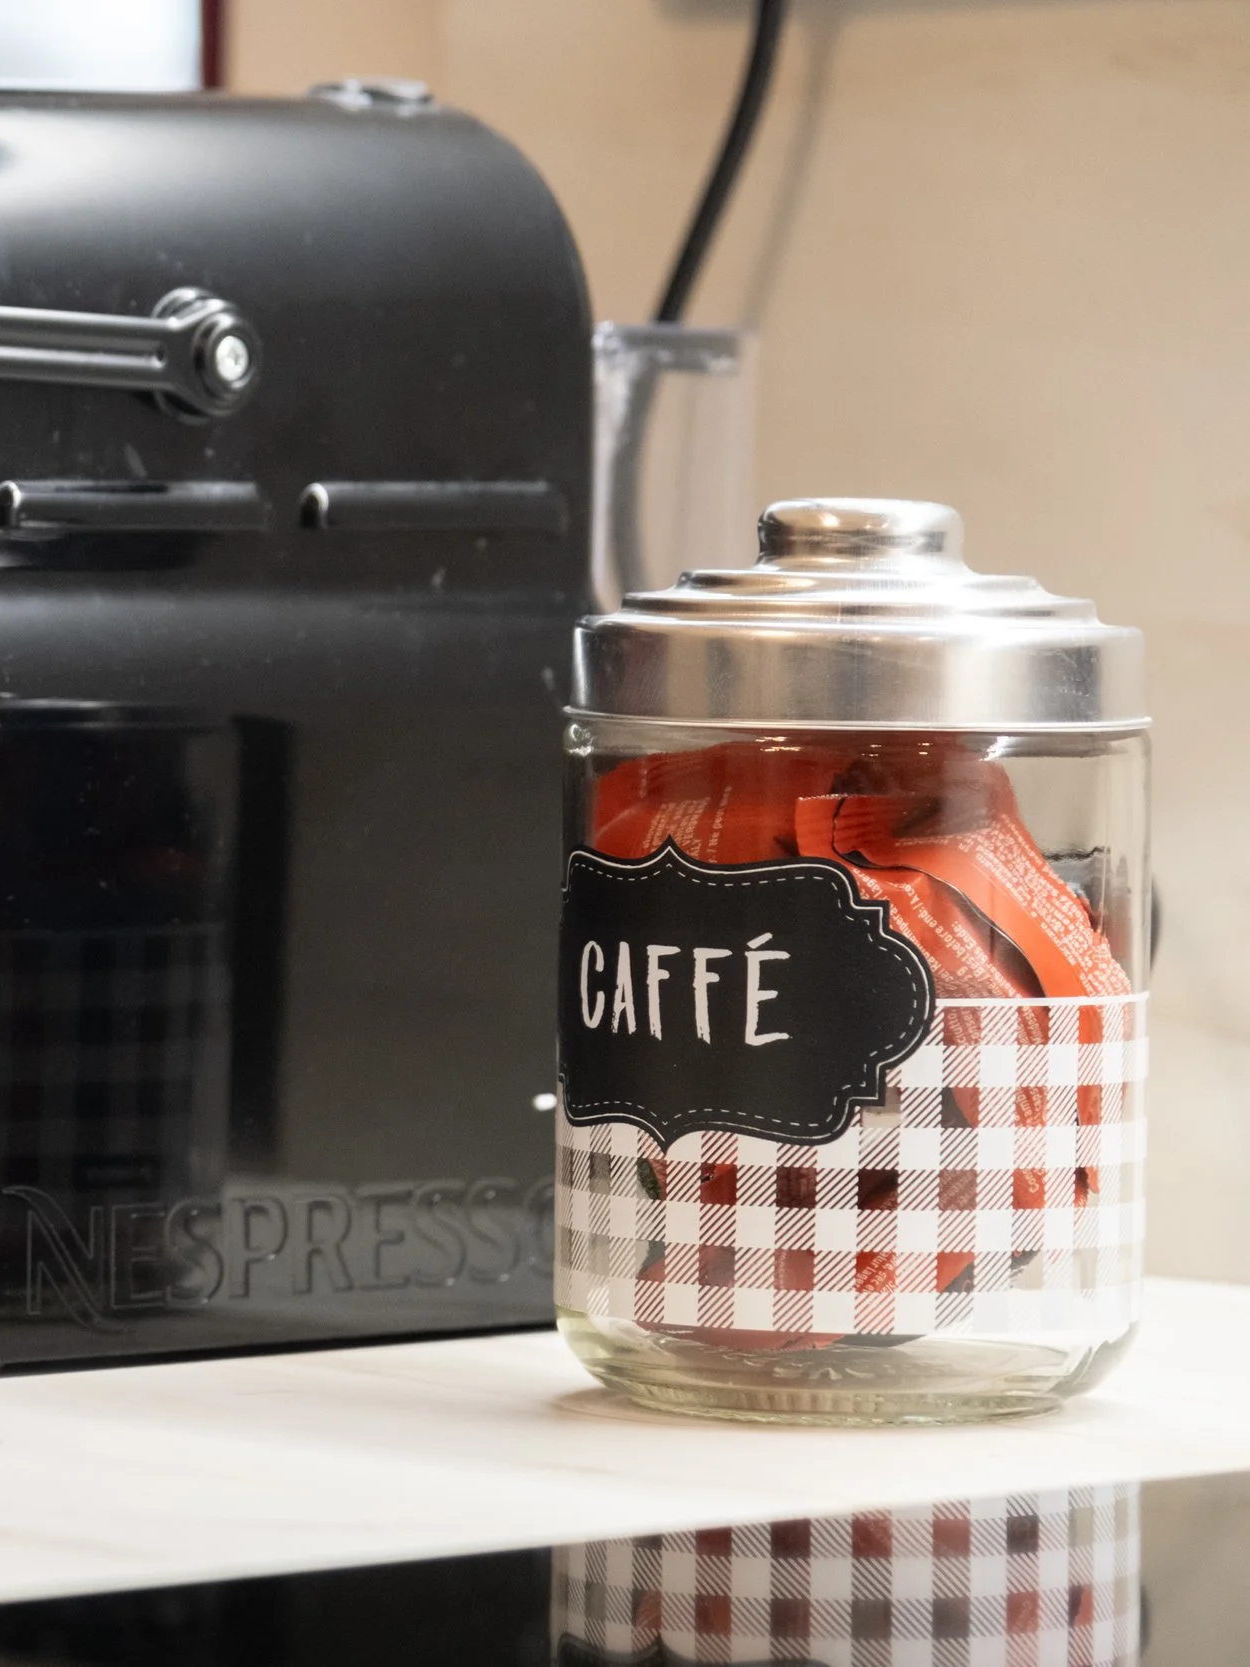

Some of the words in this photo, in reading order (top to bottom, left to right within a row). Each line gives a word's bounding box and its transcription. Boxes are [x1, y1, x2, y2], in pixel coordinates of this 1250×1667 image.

[935, 926, 966, 958] before
[951, 921, 977, 950] Ende:
[961, 953, 985, 977] Best
[581, 932, 791, 1046] CAFFÉ
